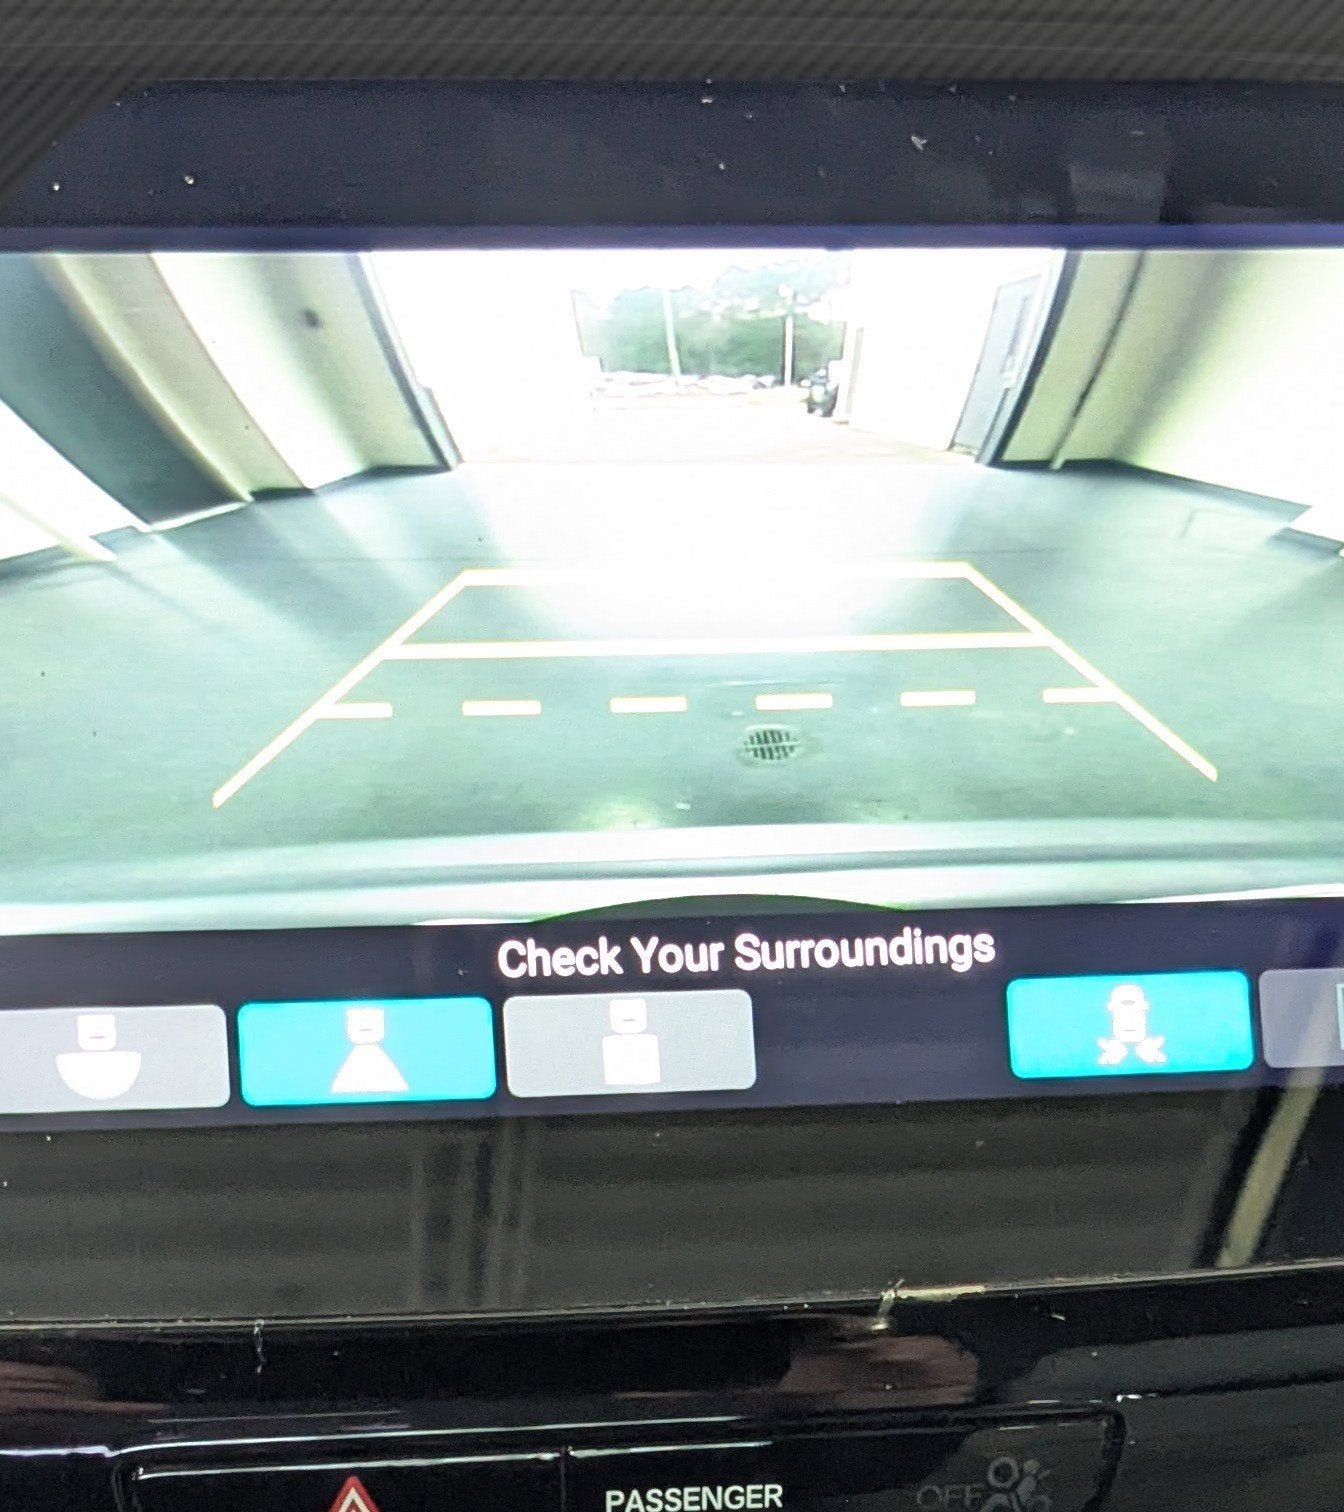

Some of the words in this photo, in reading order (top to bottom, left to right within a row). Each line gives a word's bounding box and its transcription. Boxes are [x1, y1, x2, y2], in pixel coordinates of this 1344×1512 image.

[497, 935, 624, 980] Check
[630, 934, 726, 975] Your
[733, 926, 997, 974] Surroundings
